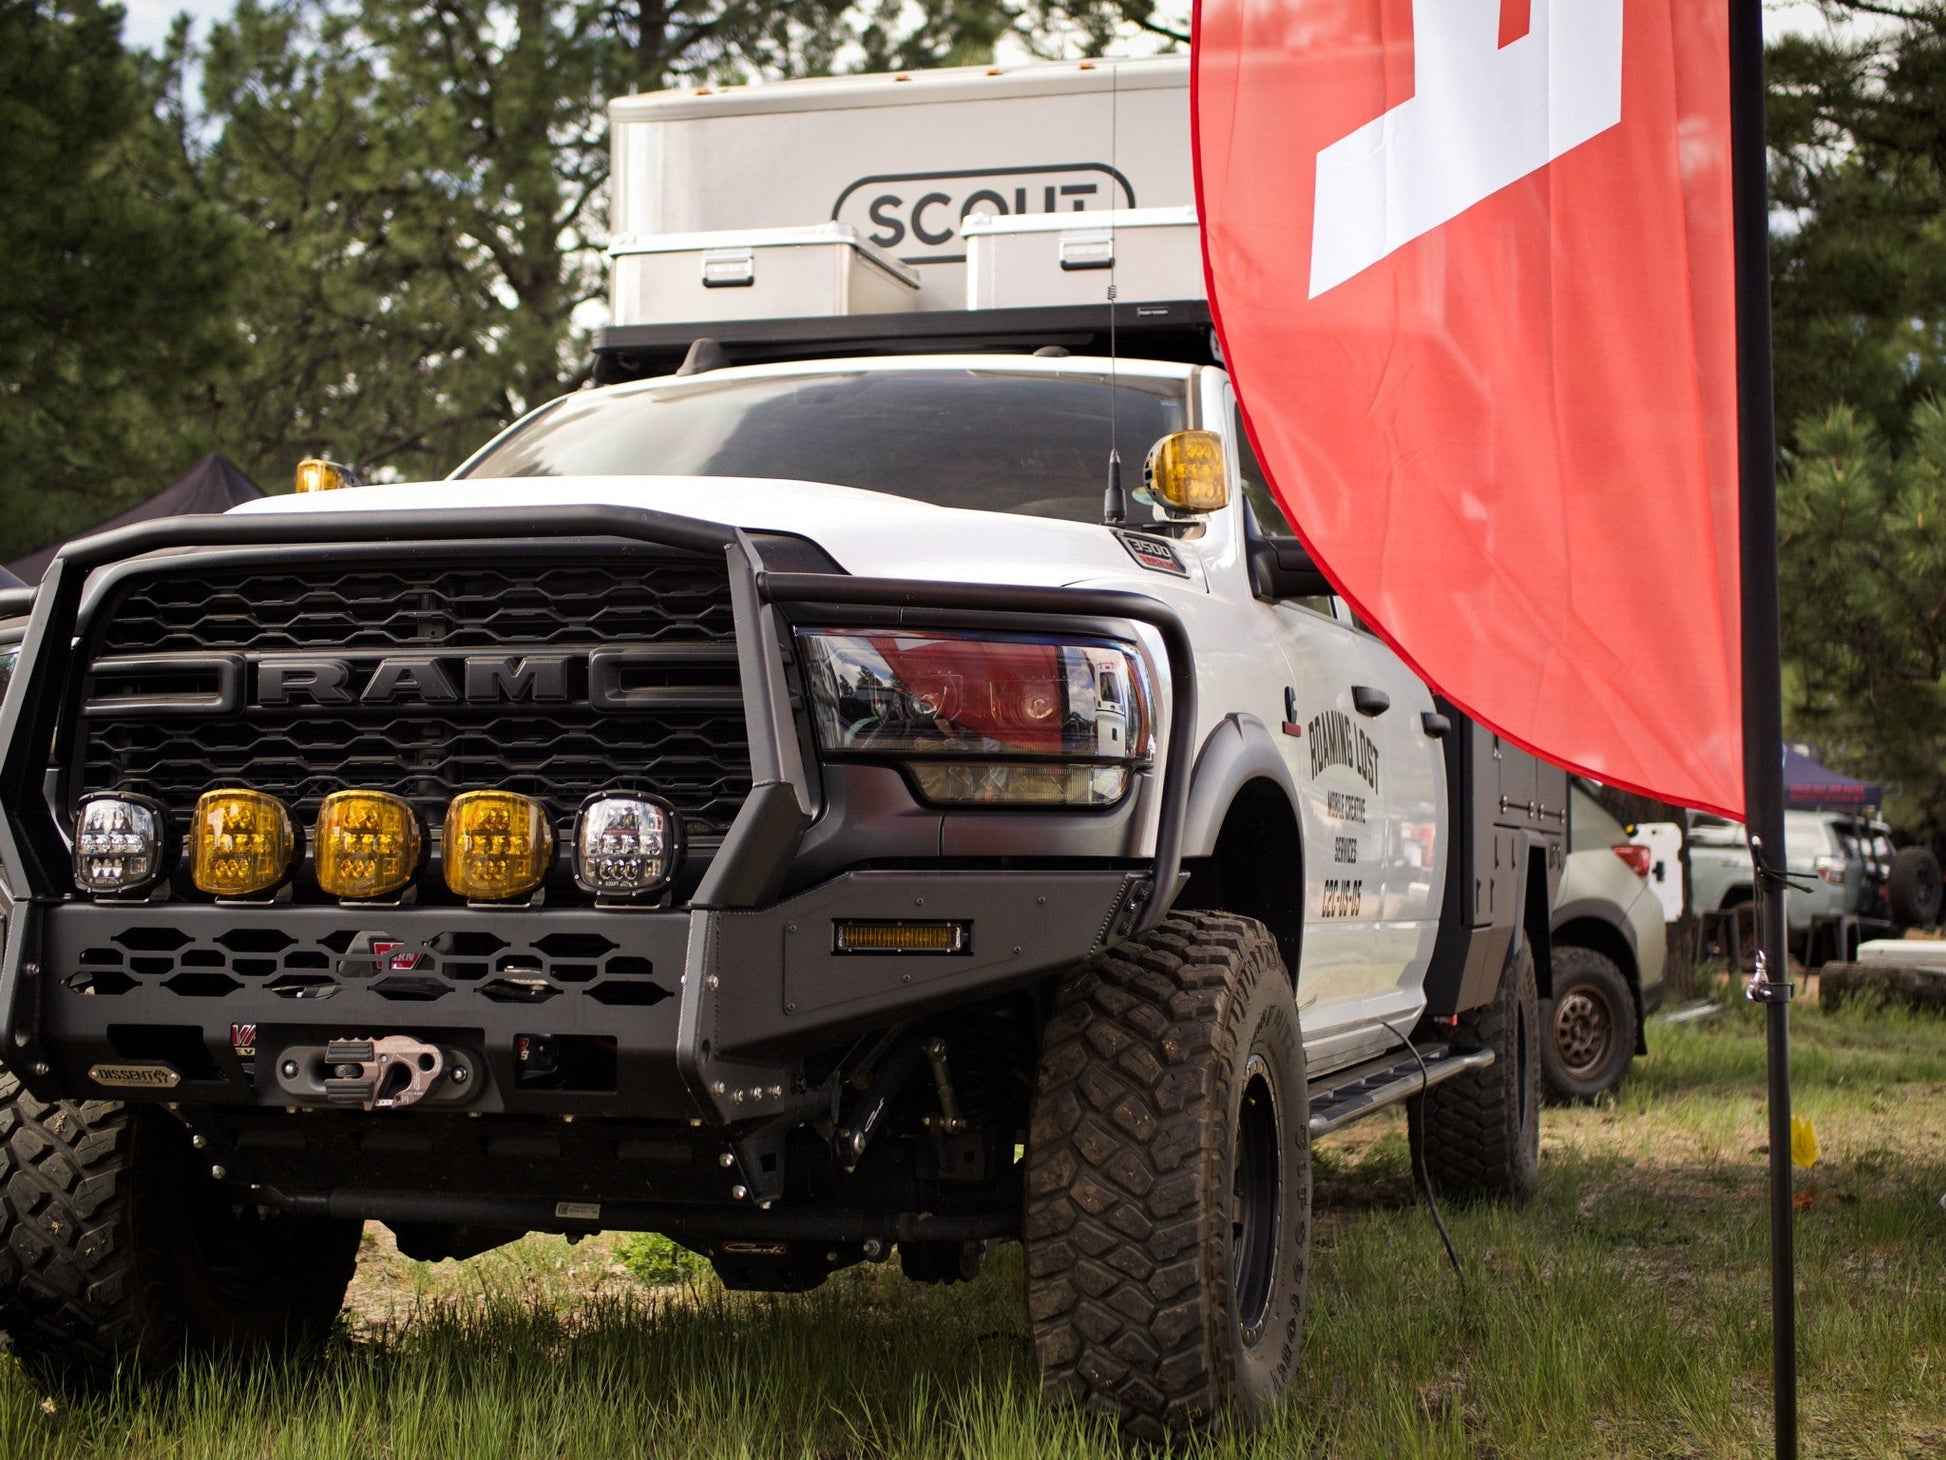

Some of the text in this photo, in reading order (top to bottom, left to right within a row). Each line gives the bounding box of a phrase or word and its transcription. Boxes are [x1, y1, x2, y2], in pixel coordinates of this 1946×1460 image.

[1128, 538, 1172, 559] 3500
[257, 656, 573, 705] RAM
[1308, 709, 1379, 796] ROAMING LOST
[1345, 794, 1366, 825] CREATIVE
[1334, 836, 1357, 864] SERVICES
[1321, 879, 1363, 918] C2C-US-05
[98, 1069, 154, 1083] DISSENT
